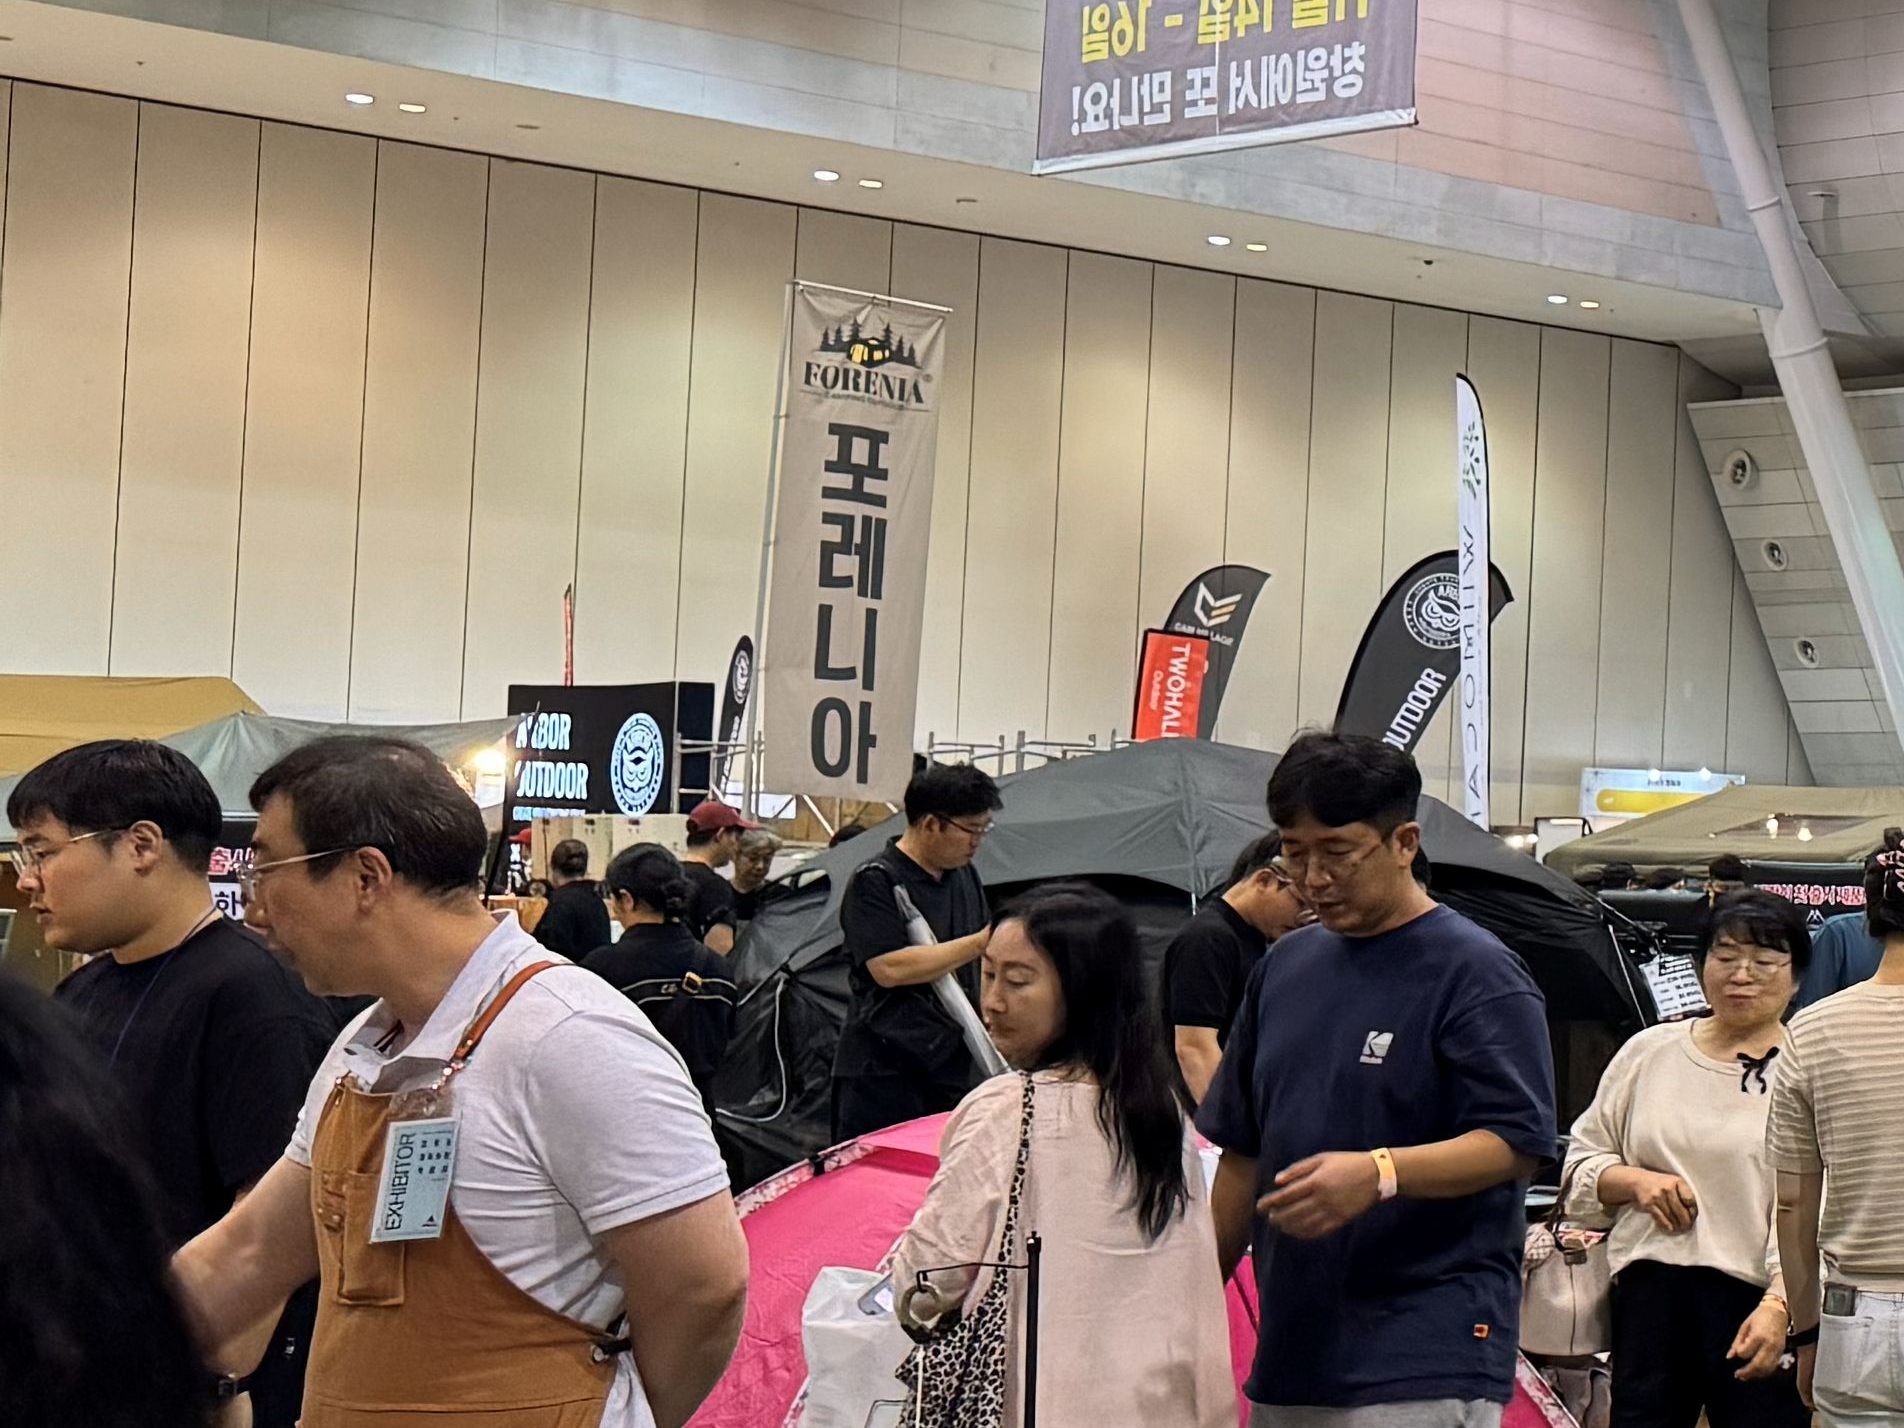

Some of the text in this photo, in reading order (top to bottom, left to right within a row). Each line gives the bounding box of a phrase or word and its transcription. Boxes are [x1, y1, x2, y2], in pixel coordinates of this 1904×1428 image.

[803, 361, 925, 404] FORENIA
[811, 421, 890, 786] 포레니아
[384, 1132, 417, 1231] EXHIBITOR
